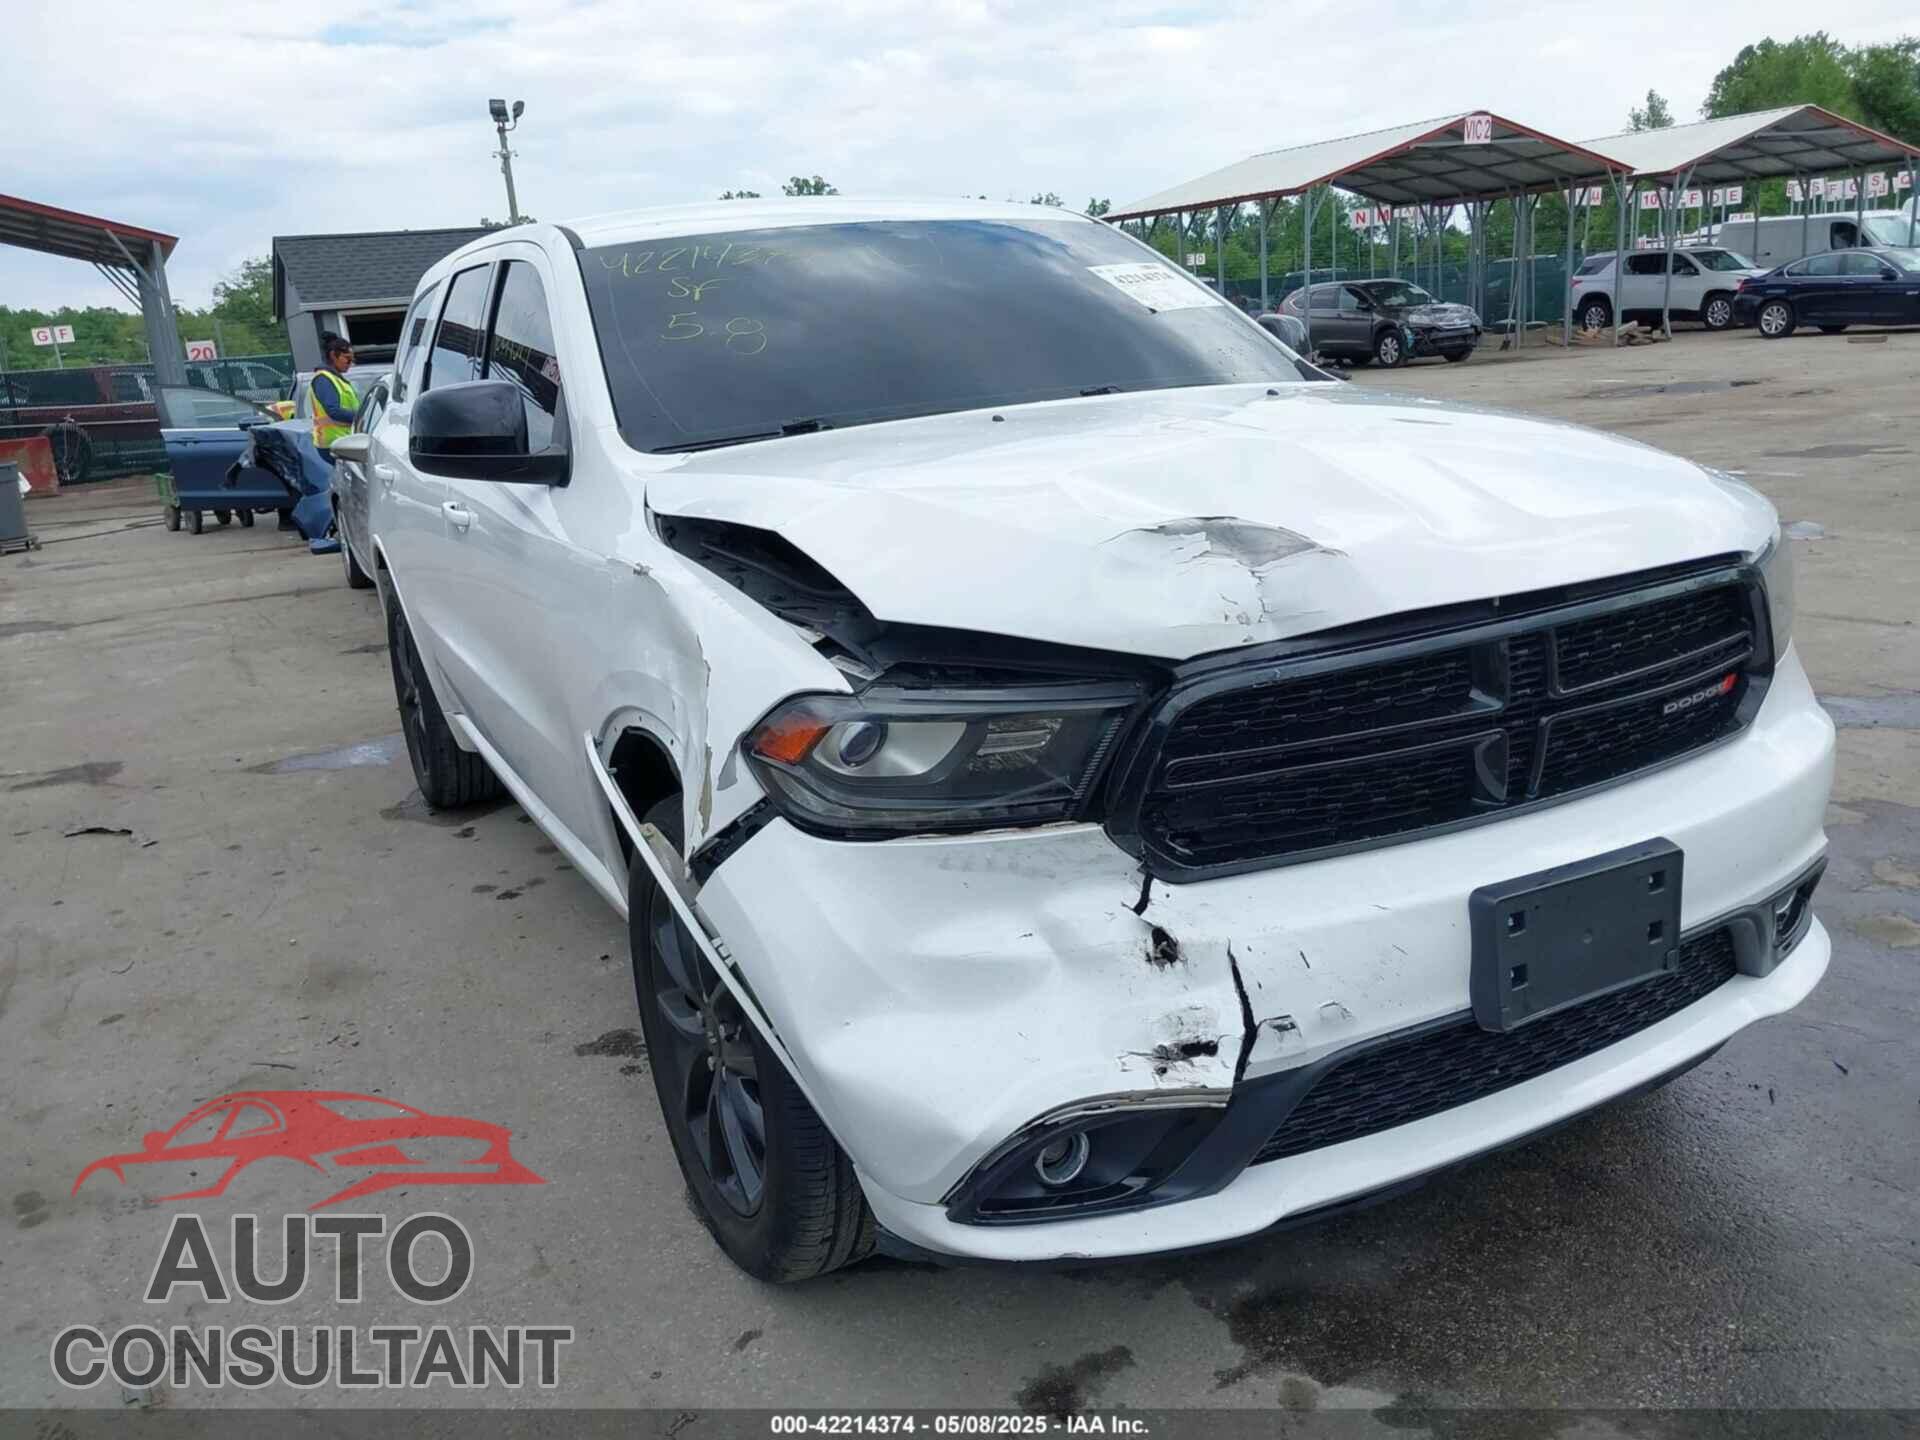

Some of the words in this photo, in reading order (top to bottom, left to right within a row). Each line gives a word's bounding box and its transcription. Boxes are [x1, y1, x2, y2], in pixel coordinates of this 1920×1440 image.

[1356, 211, 1366, 225] N
[36, 330, 48, 342] G
[58, 328, 68, 341] F
[190, 347, 214, 361] 20
